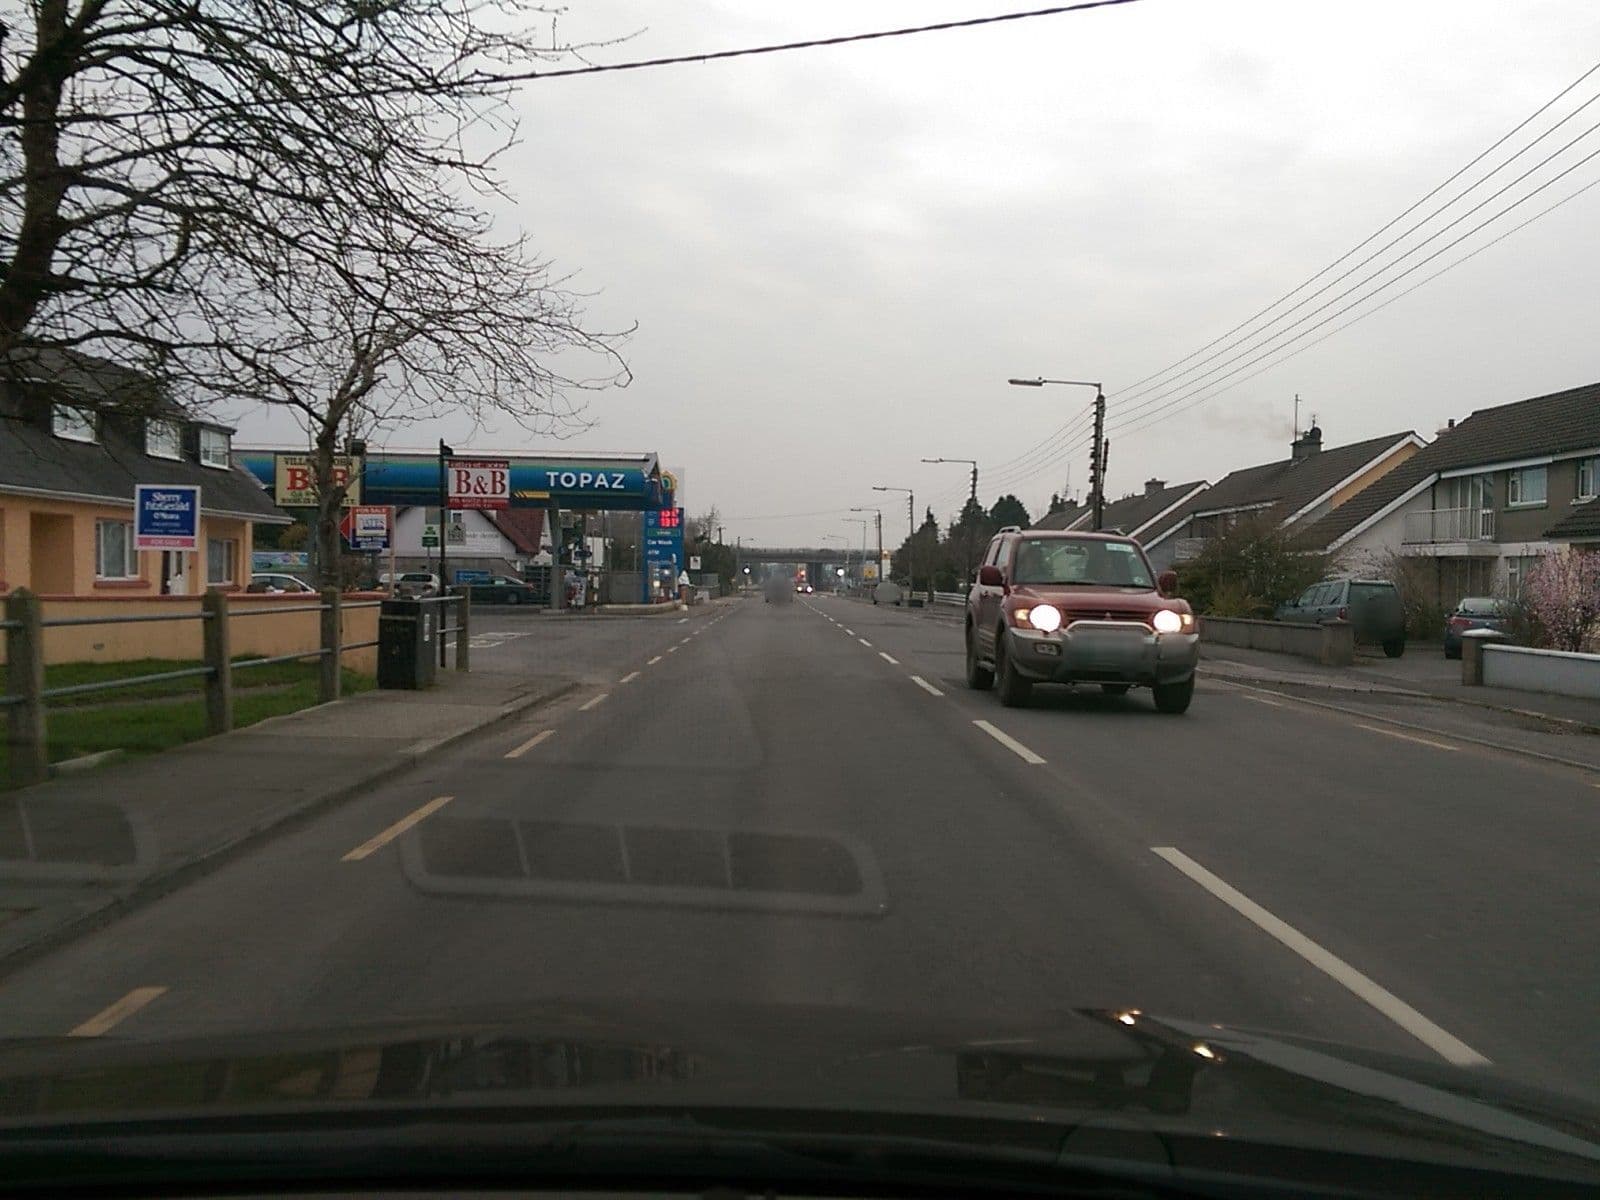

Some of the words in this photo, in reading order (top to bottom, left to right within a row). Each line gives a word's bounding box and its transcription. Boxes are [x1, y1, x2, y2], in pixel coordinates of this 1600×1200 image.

[455, 469, 506, 495] B&B
[545, 471, 625, 489] TOPAZ
[152, 492, 181, 504] Sherry
